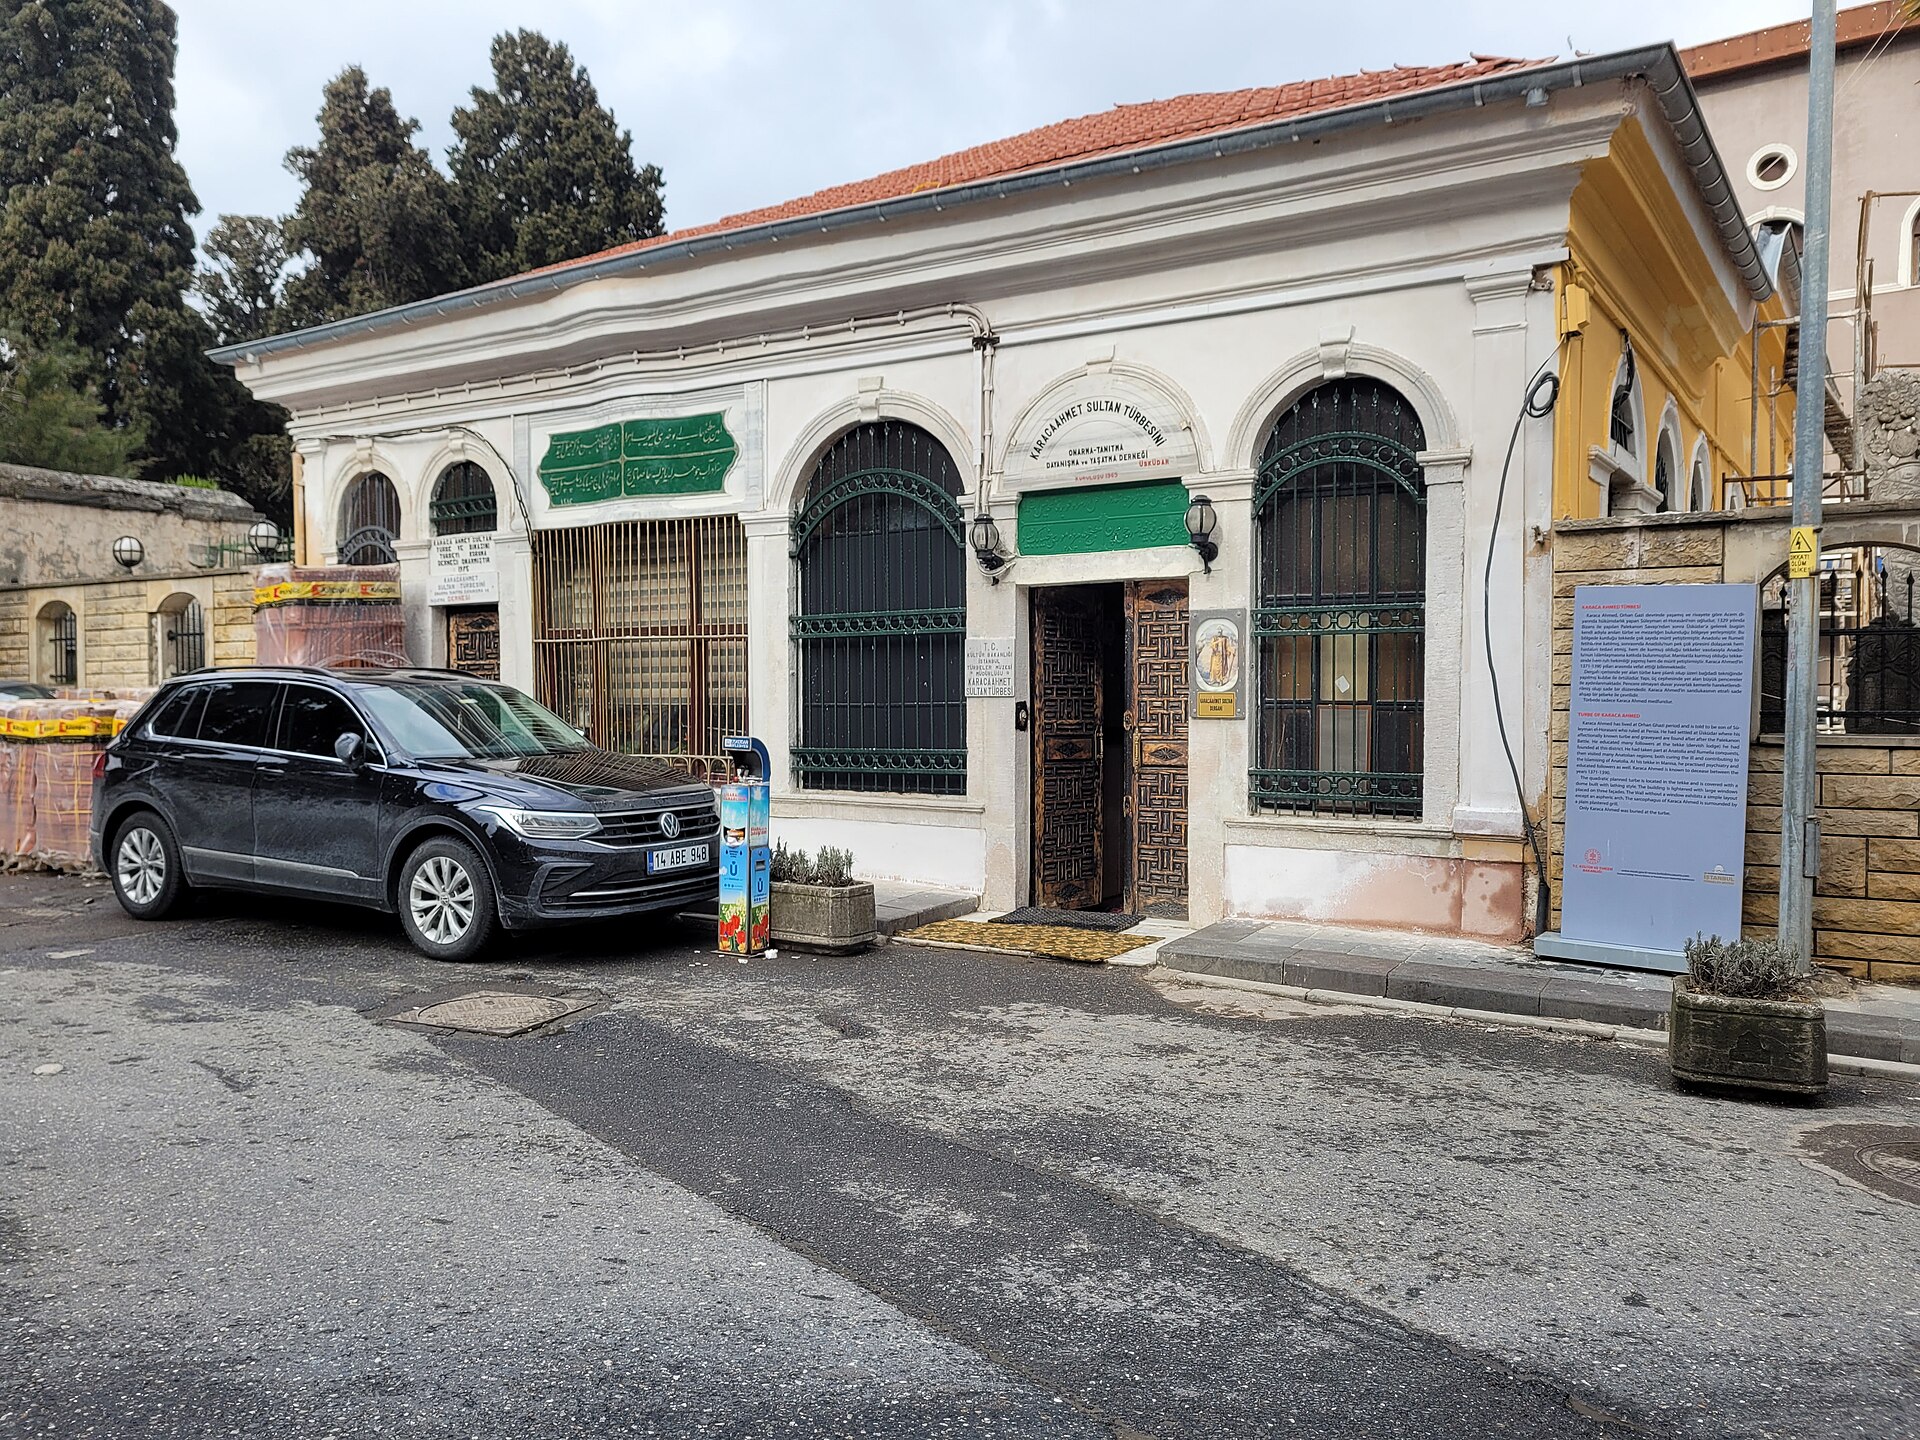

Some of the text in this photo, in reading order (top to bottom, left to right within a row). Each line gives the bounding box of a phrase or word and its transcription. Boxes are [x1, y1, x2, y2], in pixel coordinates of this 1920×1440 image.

[1030, 400, 1167, 460] KARACAAHMET SULTAN TÜRBESİNİ
[1119, 449, 1149, 461] DERNEĞİ
[655, 846, 707, 867] 14 ABE 948
